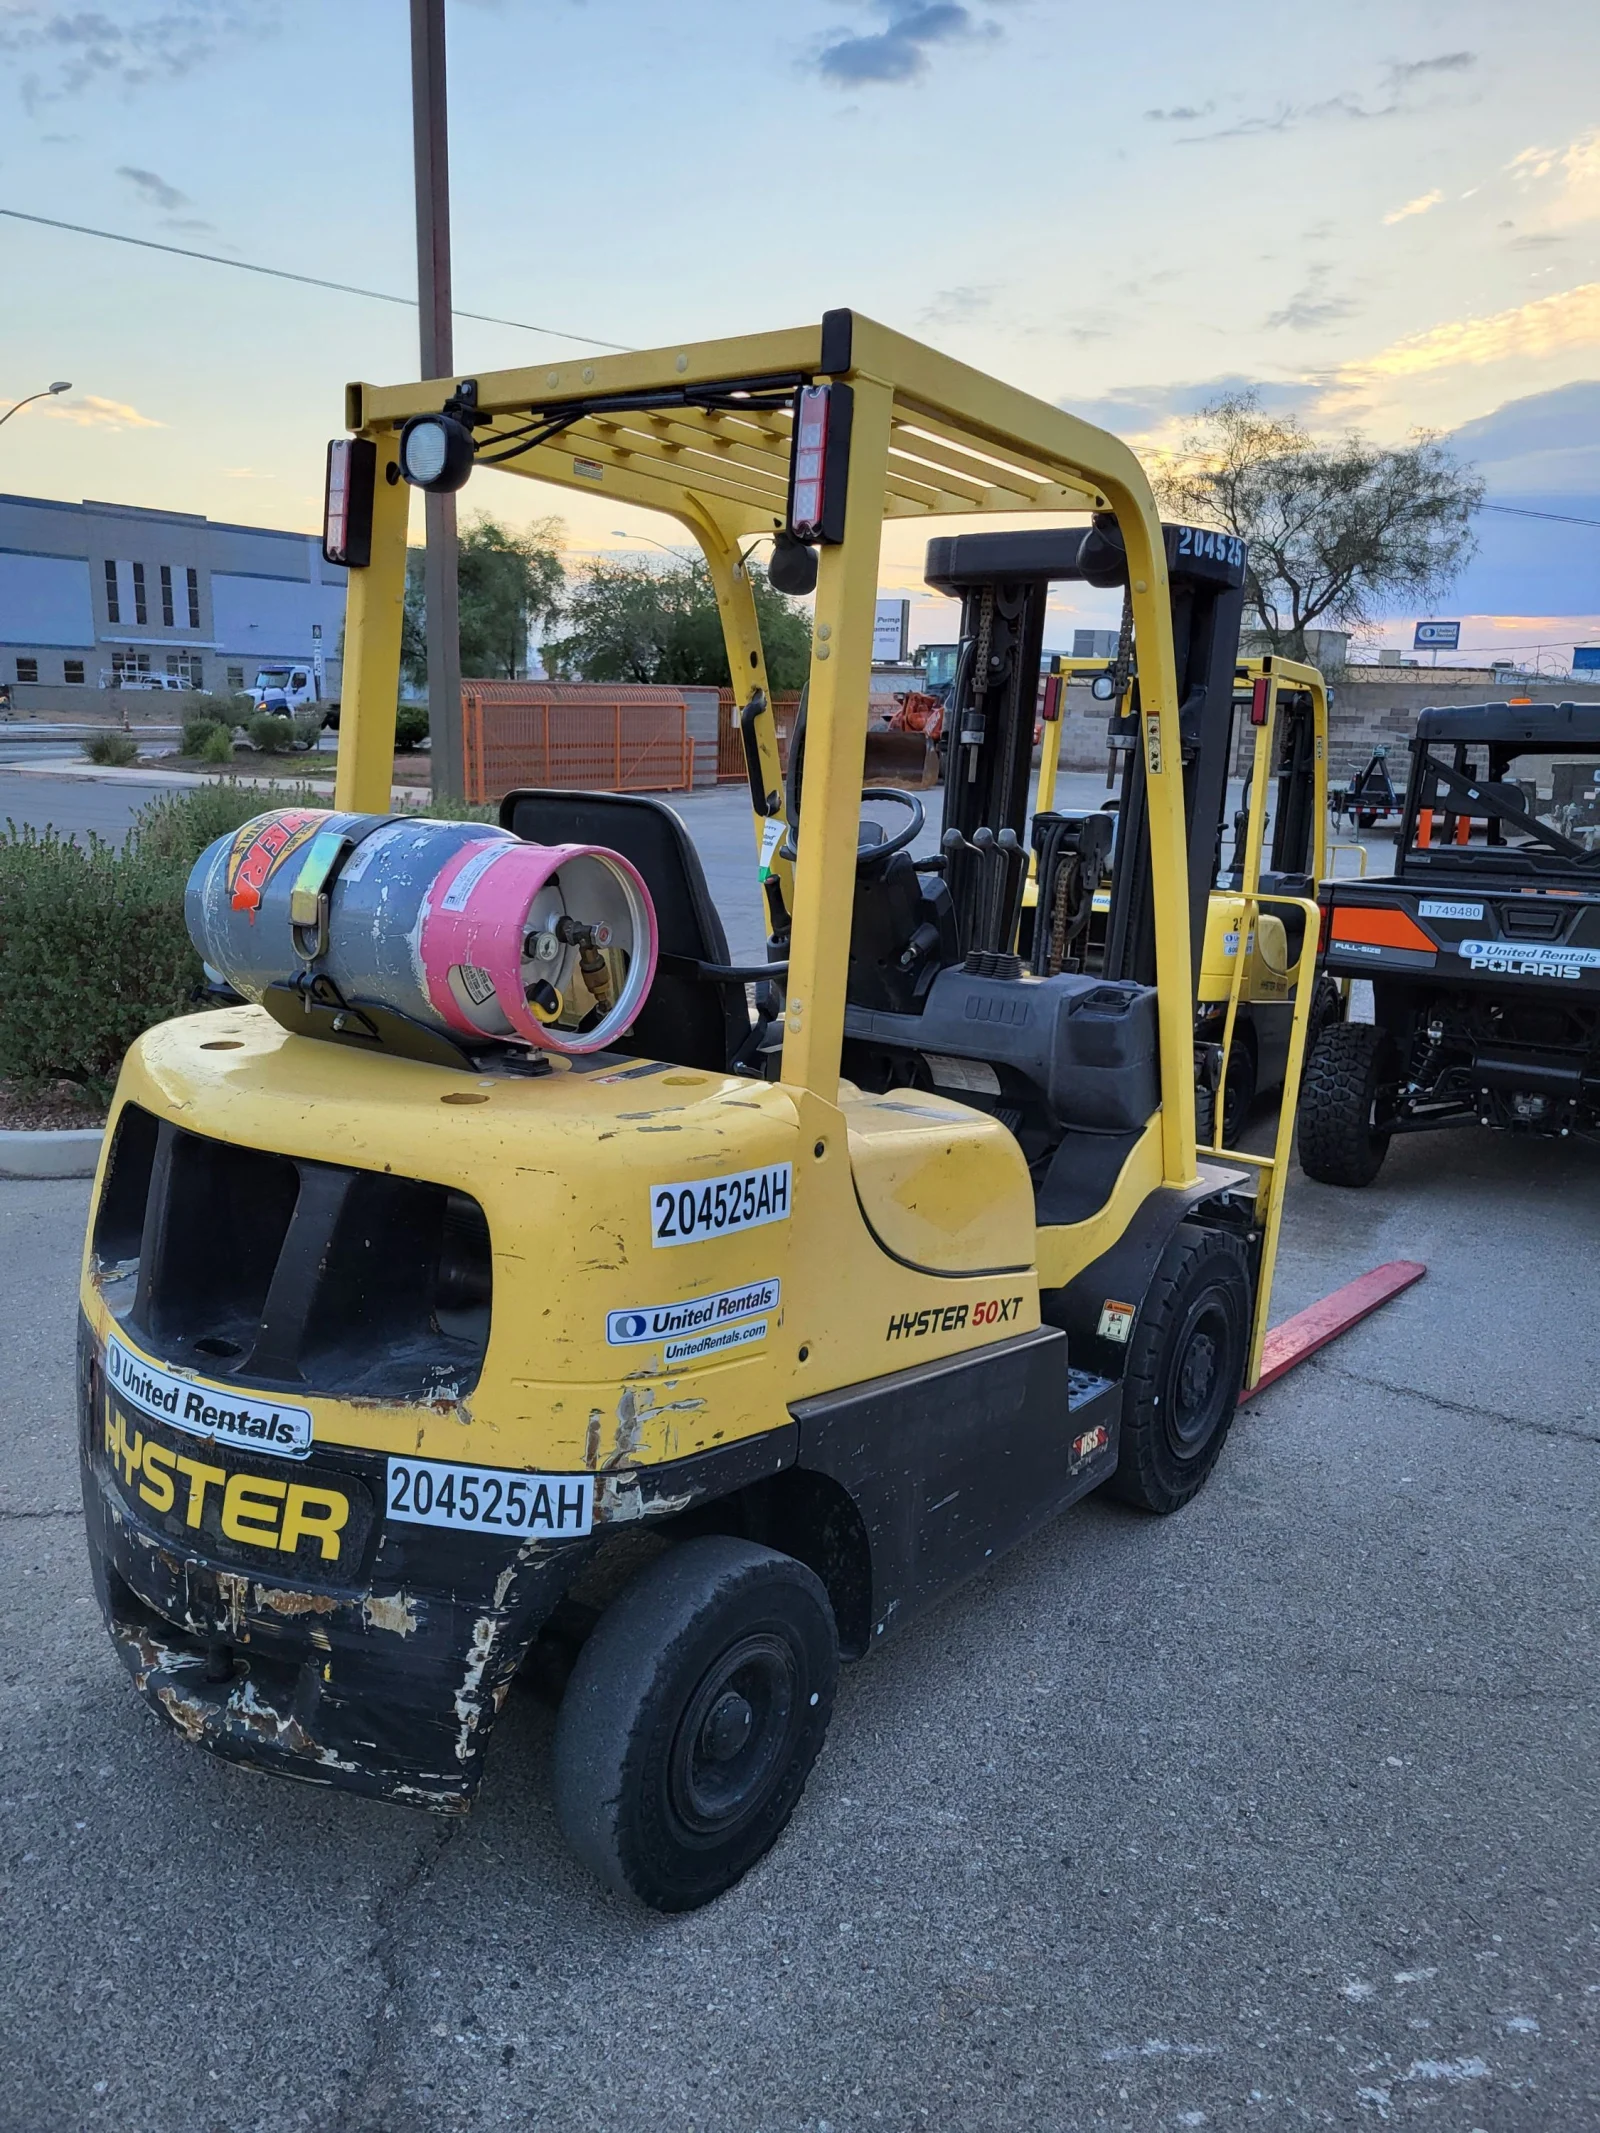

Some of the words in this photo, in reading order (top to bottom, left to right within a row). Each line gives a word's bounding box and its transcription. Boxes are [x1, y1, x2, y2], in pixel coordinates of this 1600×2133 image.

[1179, 527, 1242, 567] 204525
[1420, 904, 1481, 918] 11749480
[1335, 942, 1382, 955] FULL-SIZE
[1471, 958, 1581, 980] POLARIS
[1486, 946, 1542, 959] United
[1543, 950, 1598, 963] Rentals
[656, 1169, 788, 1239] 204525AH
[653, 1301, 714, 1333] United
[717, 1287, 772, 1318] Rentals
[886, 1304, 970, 1341] HYSTER
[972, 1297, 1023, 1327] 50XT
[666, 1324, 766, 1360] UnitedRentals.com
[122, 1359, 180, 1414] United
[183, 1391, 296, 1445] Rentals
[104, 1394, 350, 1561] HYSTER
[391, 1466, 585, 1529] 204525AH
